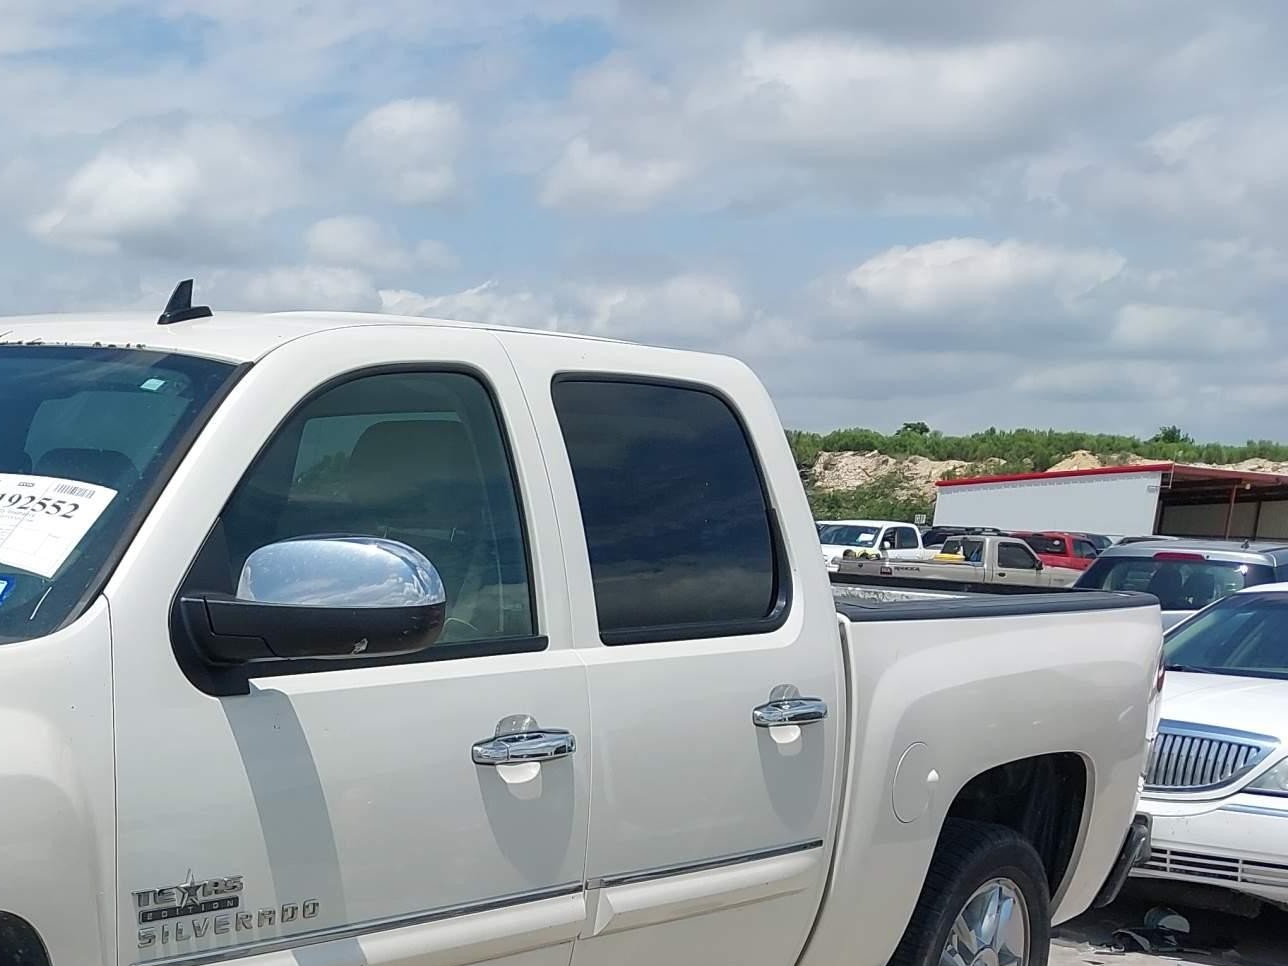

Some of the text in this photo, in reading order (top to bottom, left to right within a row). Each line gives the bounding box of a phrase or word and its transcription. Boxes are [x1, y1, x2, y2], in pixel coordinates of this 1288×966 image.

[131, 872, 244, 908] TEXAS
[137, 898, 320, 949] SILVERADO
[144, 899, 235, 921] EDITION
